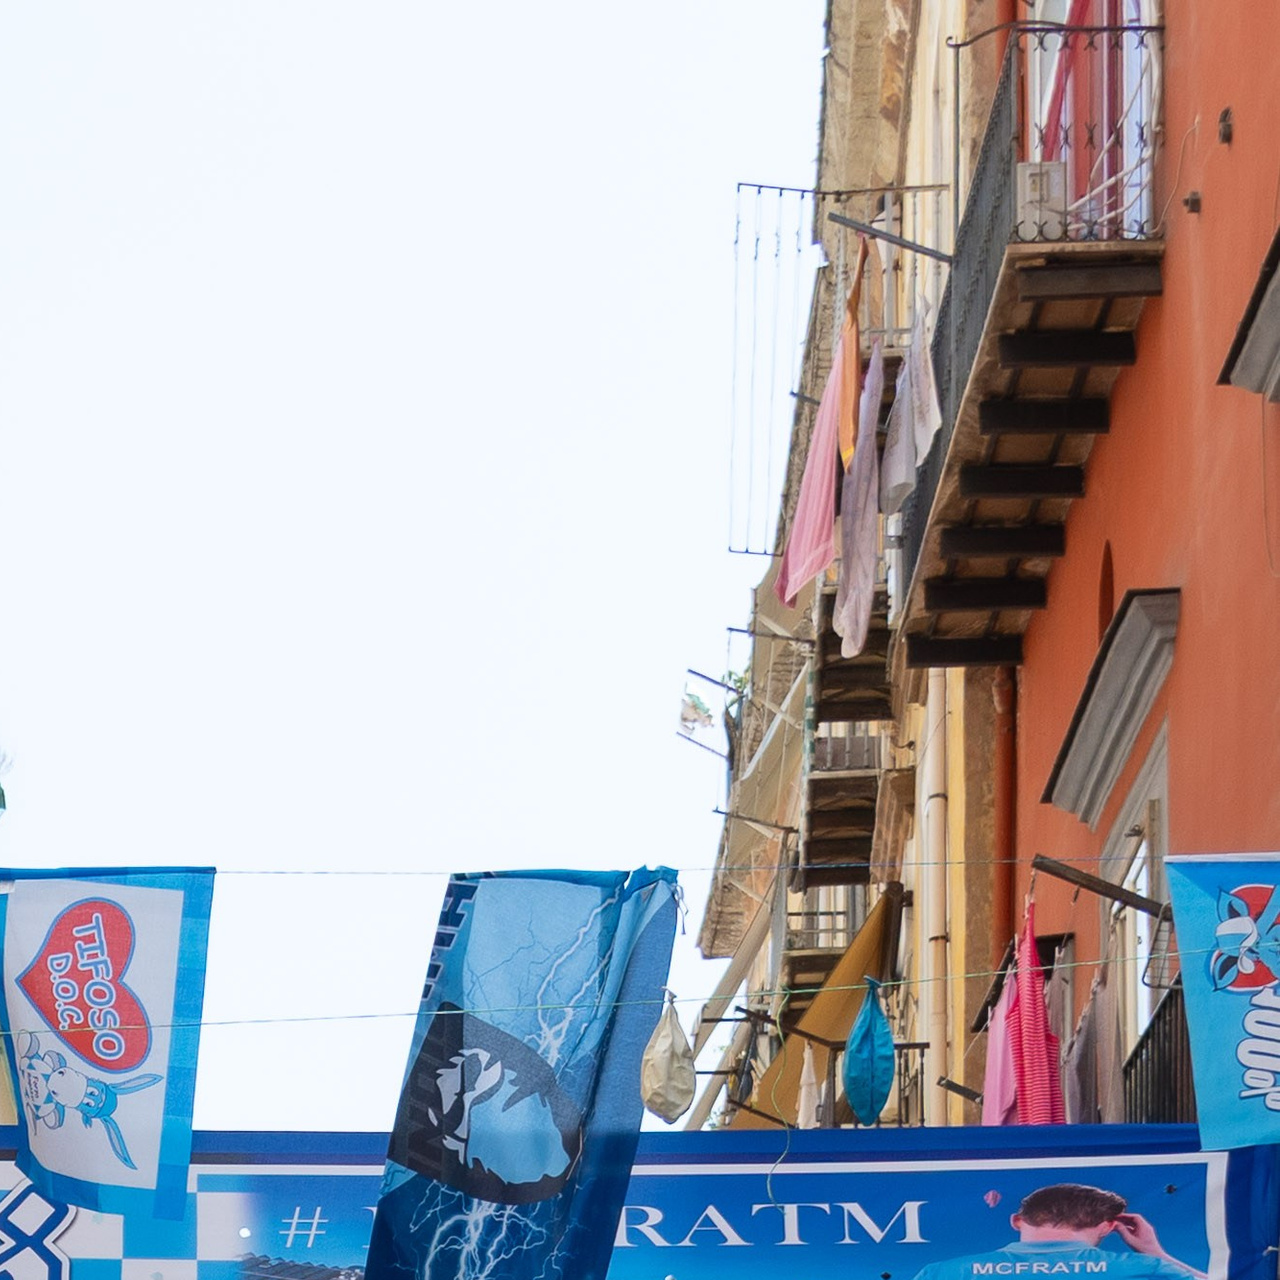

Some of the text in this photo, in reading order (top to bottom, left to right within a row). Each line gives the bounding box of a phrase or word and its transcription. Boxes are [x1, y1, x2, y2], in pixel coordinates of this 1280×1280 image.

[47, 952, 84, 1031] D.O.C.
[73, 912, 125, 1060] TIFOSO
[972, 1261, 1108, 1275] MCFRATM
